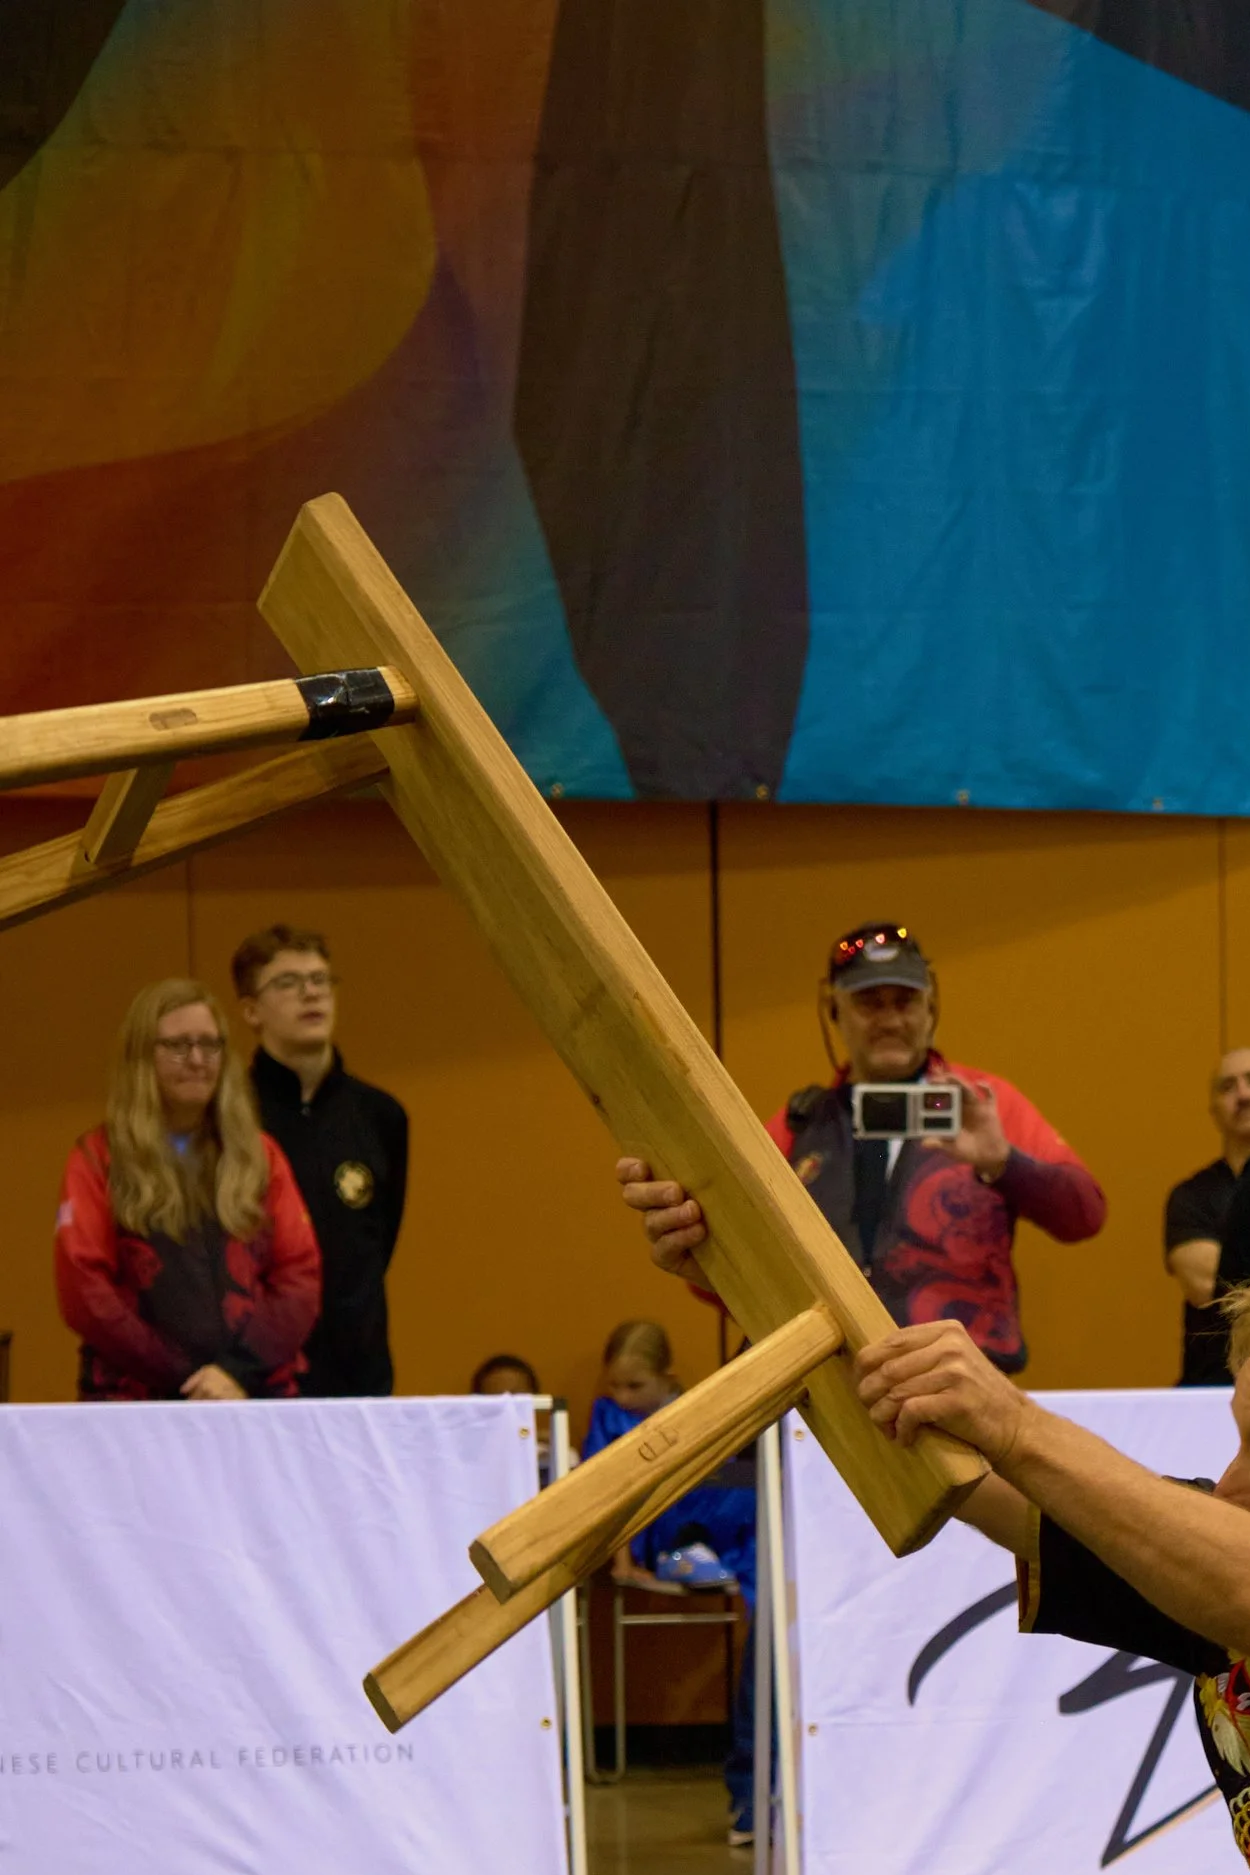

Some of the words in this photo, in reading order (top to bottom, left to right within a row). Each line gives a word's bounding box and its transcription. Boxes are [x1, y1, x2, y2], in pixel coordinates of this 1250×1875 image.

[0, 1752, 57, 1775] ESE
[76, 1749, 222, 1774] CULTURAL
[238, 1743, 414, 1768] FEDERATION
